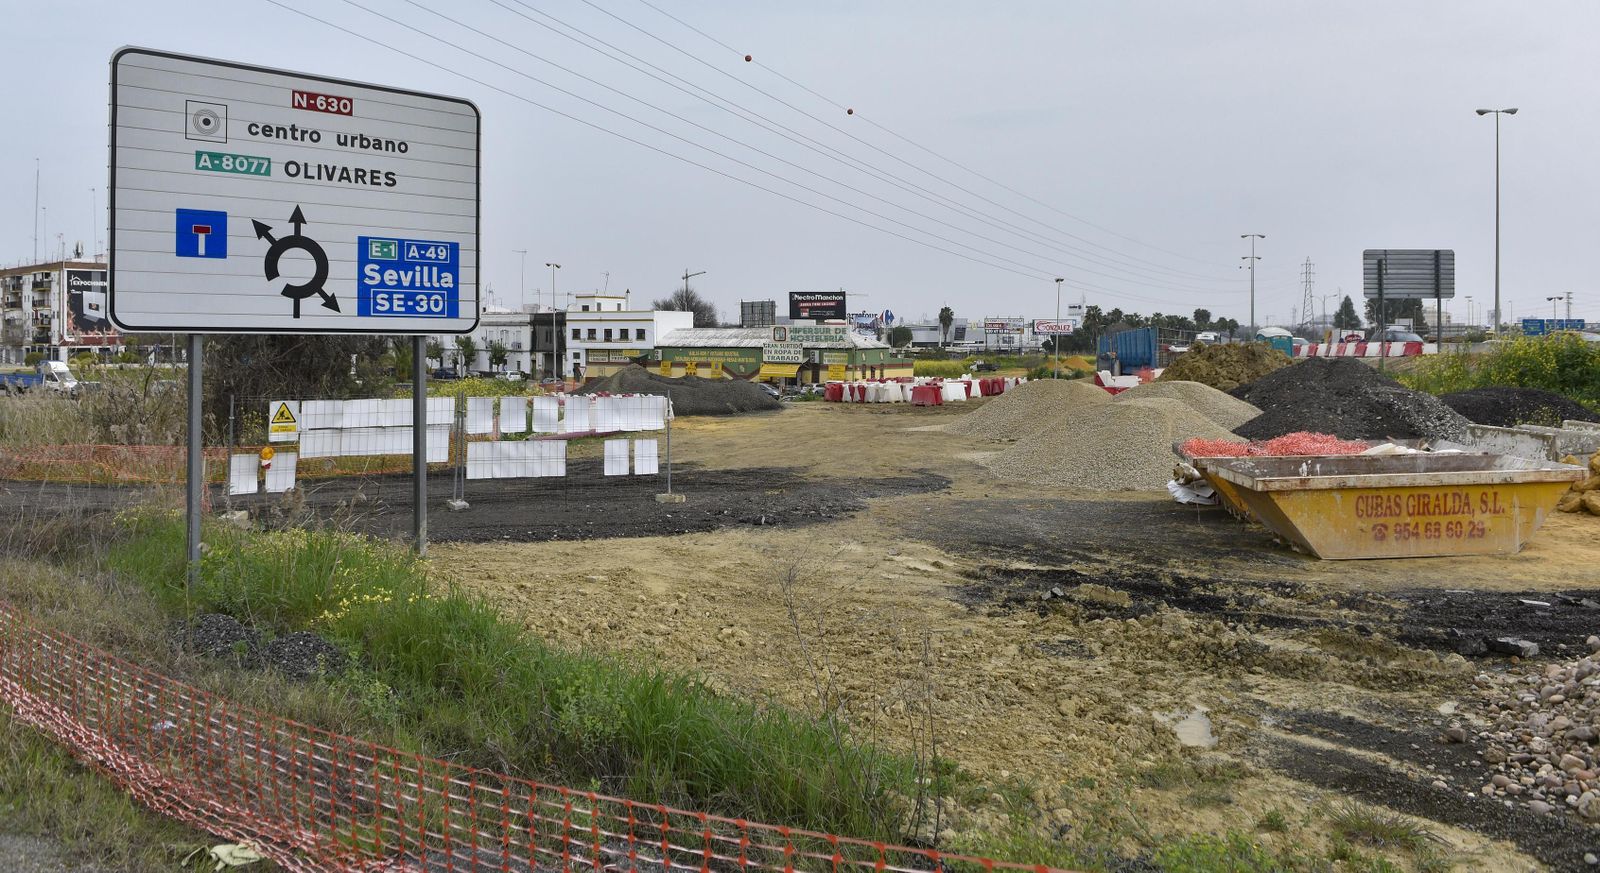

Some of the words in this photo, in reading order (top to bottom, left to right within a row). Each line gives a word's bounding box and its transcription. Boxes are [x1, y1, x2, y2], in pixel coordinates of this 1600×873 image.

[293, 92, 352, 114] N-630
[247, 121, 322, 143] centro
[336, 131, 409, 153] urbano
[198, 153, 270, 174] A-8077
[284, 161, 397, 187] OLIVARES
[371, 242, 396, 258] E-1
[408, 244, 447, 260] A-49
[363, 264, 454, 288] Sevilla
[375, 293, 444, 312] SE-30
[789, 327, 831, 335] HIPERSUR
[834, 327, 847, 335] DE
[1355, 494, 1401, 518] CUBAS
[1406, 492, 1475, 518] GIRALDA,
[1480, 491, 1505, 515] S.L.
[1394, 522, 1419, 541] 954
[1445, 521, 1463, 539] 60
